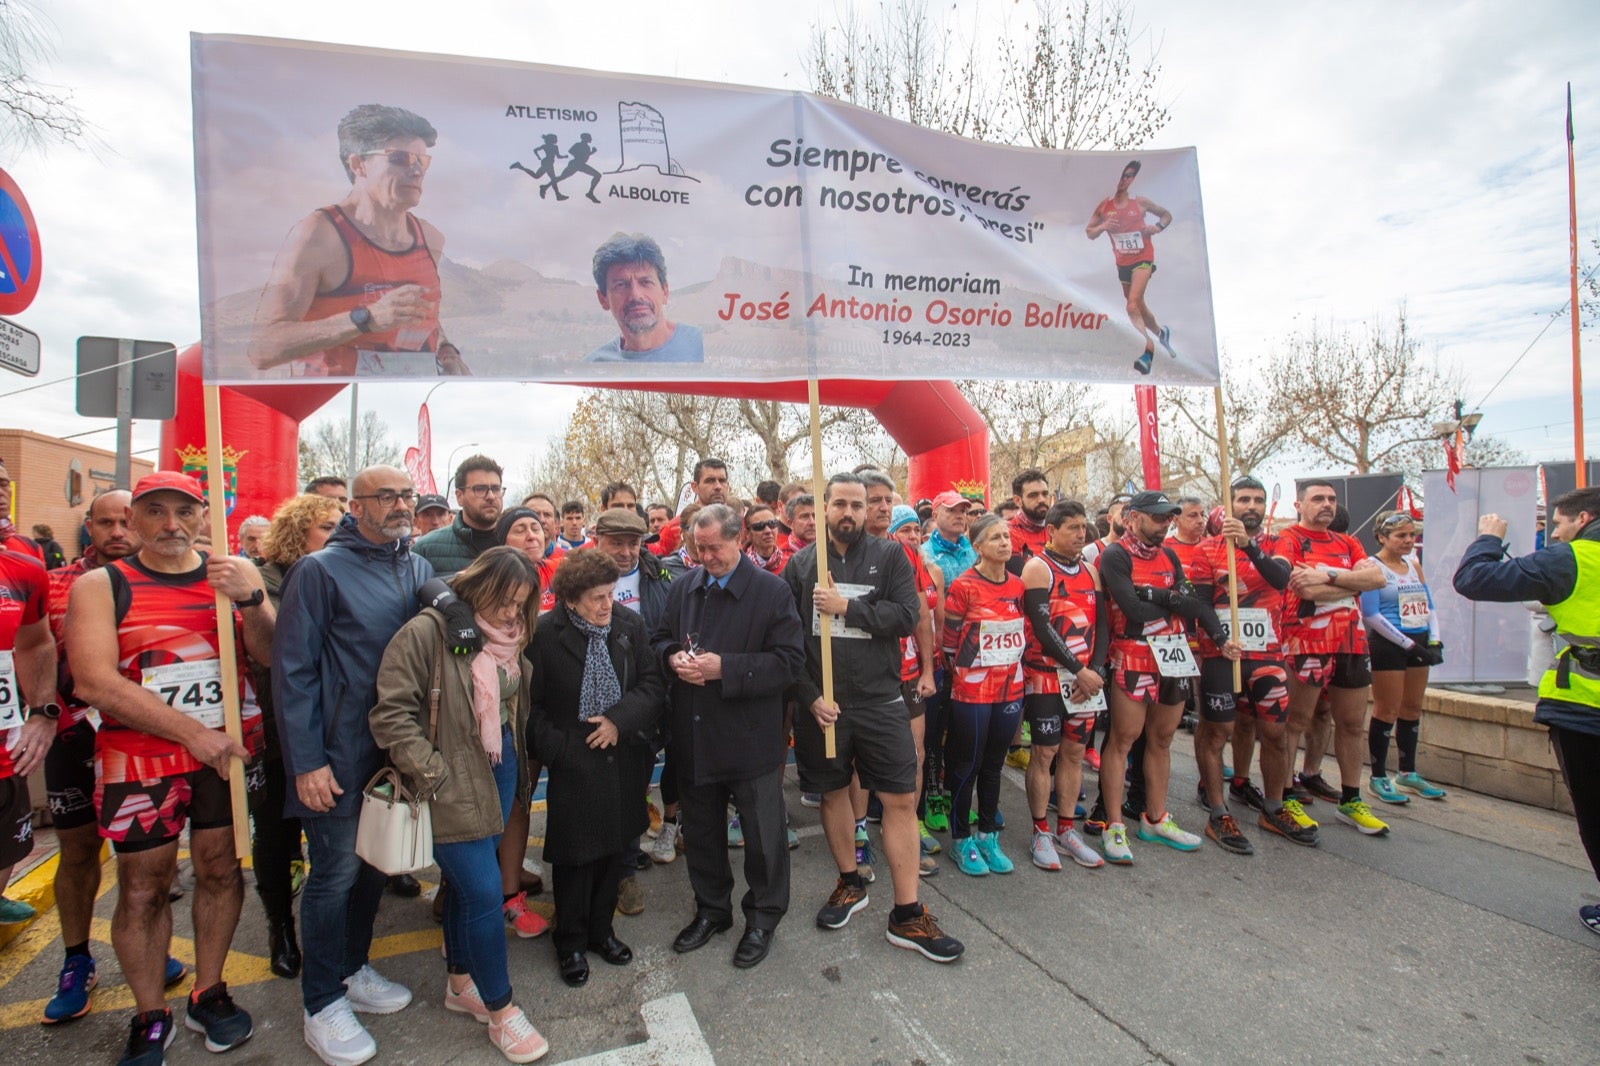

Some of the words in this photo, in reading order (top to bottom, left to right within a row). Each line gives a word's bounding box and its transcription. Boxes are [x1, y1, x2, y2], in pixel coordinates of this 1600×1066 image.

[505, 105, 598, 122] ATLETISMO
[766, 138, 903, 181] Siempre
[914, 171, 1031, 212] correrás
[608, 184, 690, 204] ALBOLOTE
[744, 184, 803, 207] con
[819, 186, 966, 222] nosotros,
[1118, 240, 1139, 249] 781
[848, 264, 873, 288] In
[884, 272, 1001, 295] memoriam
[718, 291, 791, 321] José
[806, 292, 912, 323] Antonio
[925, 299, 1012, 327] Osorio
[1024, 303, 1109, 330] Bolívar
[882, 329, 971, 347] 1964-2023
[1402, 601, 1429, 616] 2102
[1221, 622, 1265, 638] 300
[982, 632, 1023, 650] 2150
[1158, 647, 1186, 663] 240
[160, 681, 223, 707] 743
